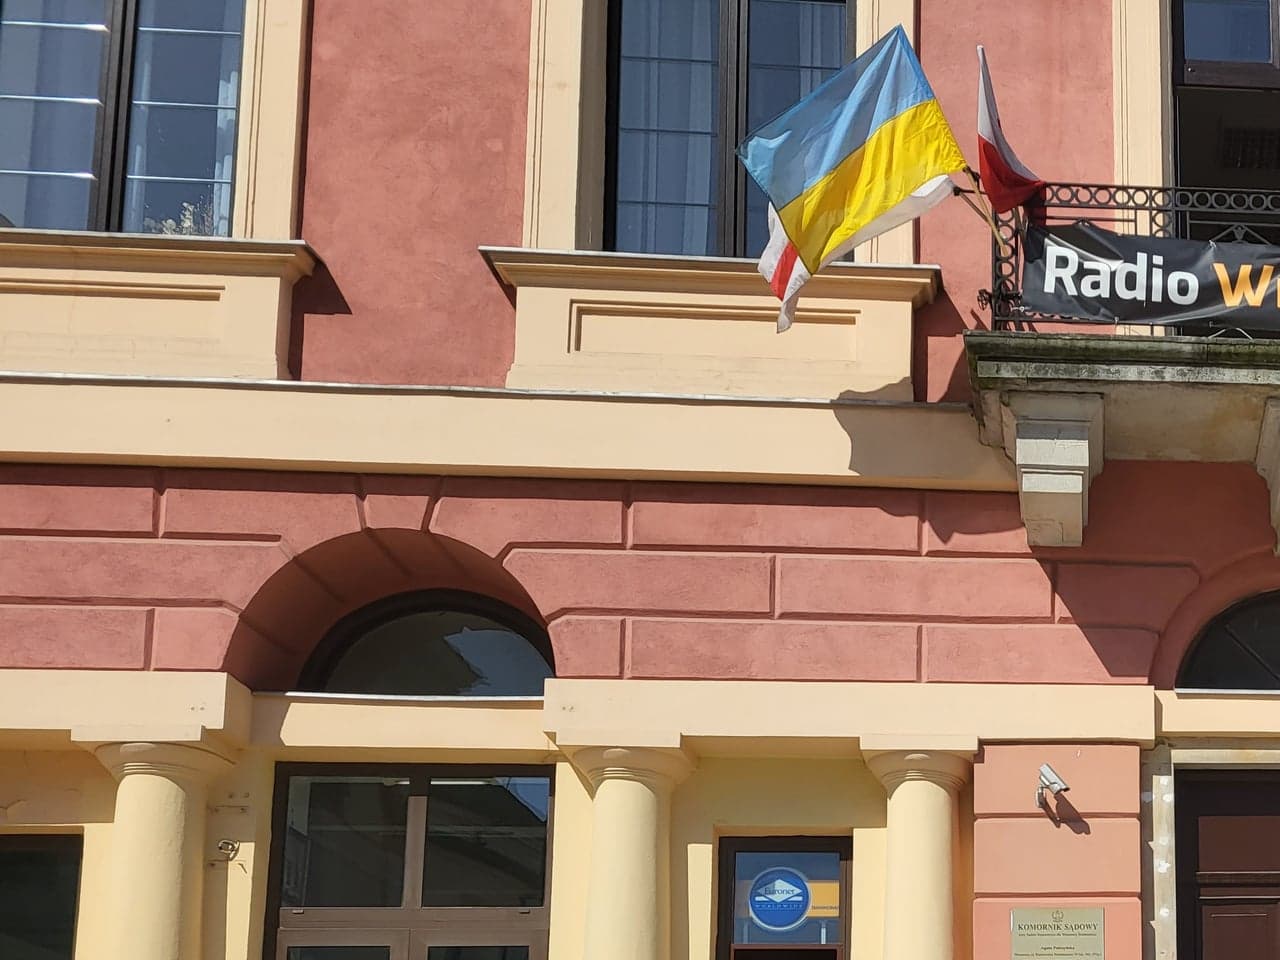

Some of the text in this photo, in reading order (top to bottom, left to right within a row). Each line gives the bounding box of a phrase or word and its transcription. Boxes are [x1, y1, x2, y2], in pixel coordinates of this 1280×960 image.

[1043, 245, 1199, 305] Radio
[1018, 922, 1098, 932] KOMORNIK SĄDOWY
